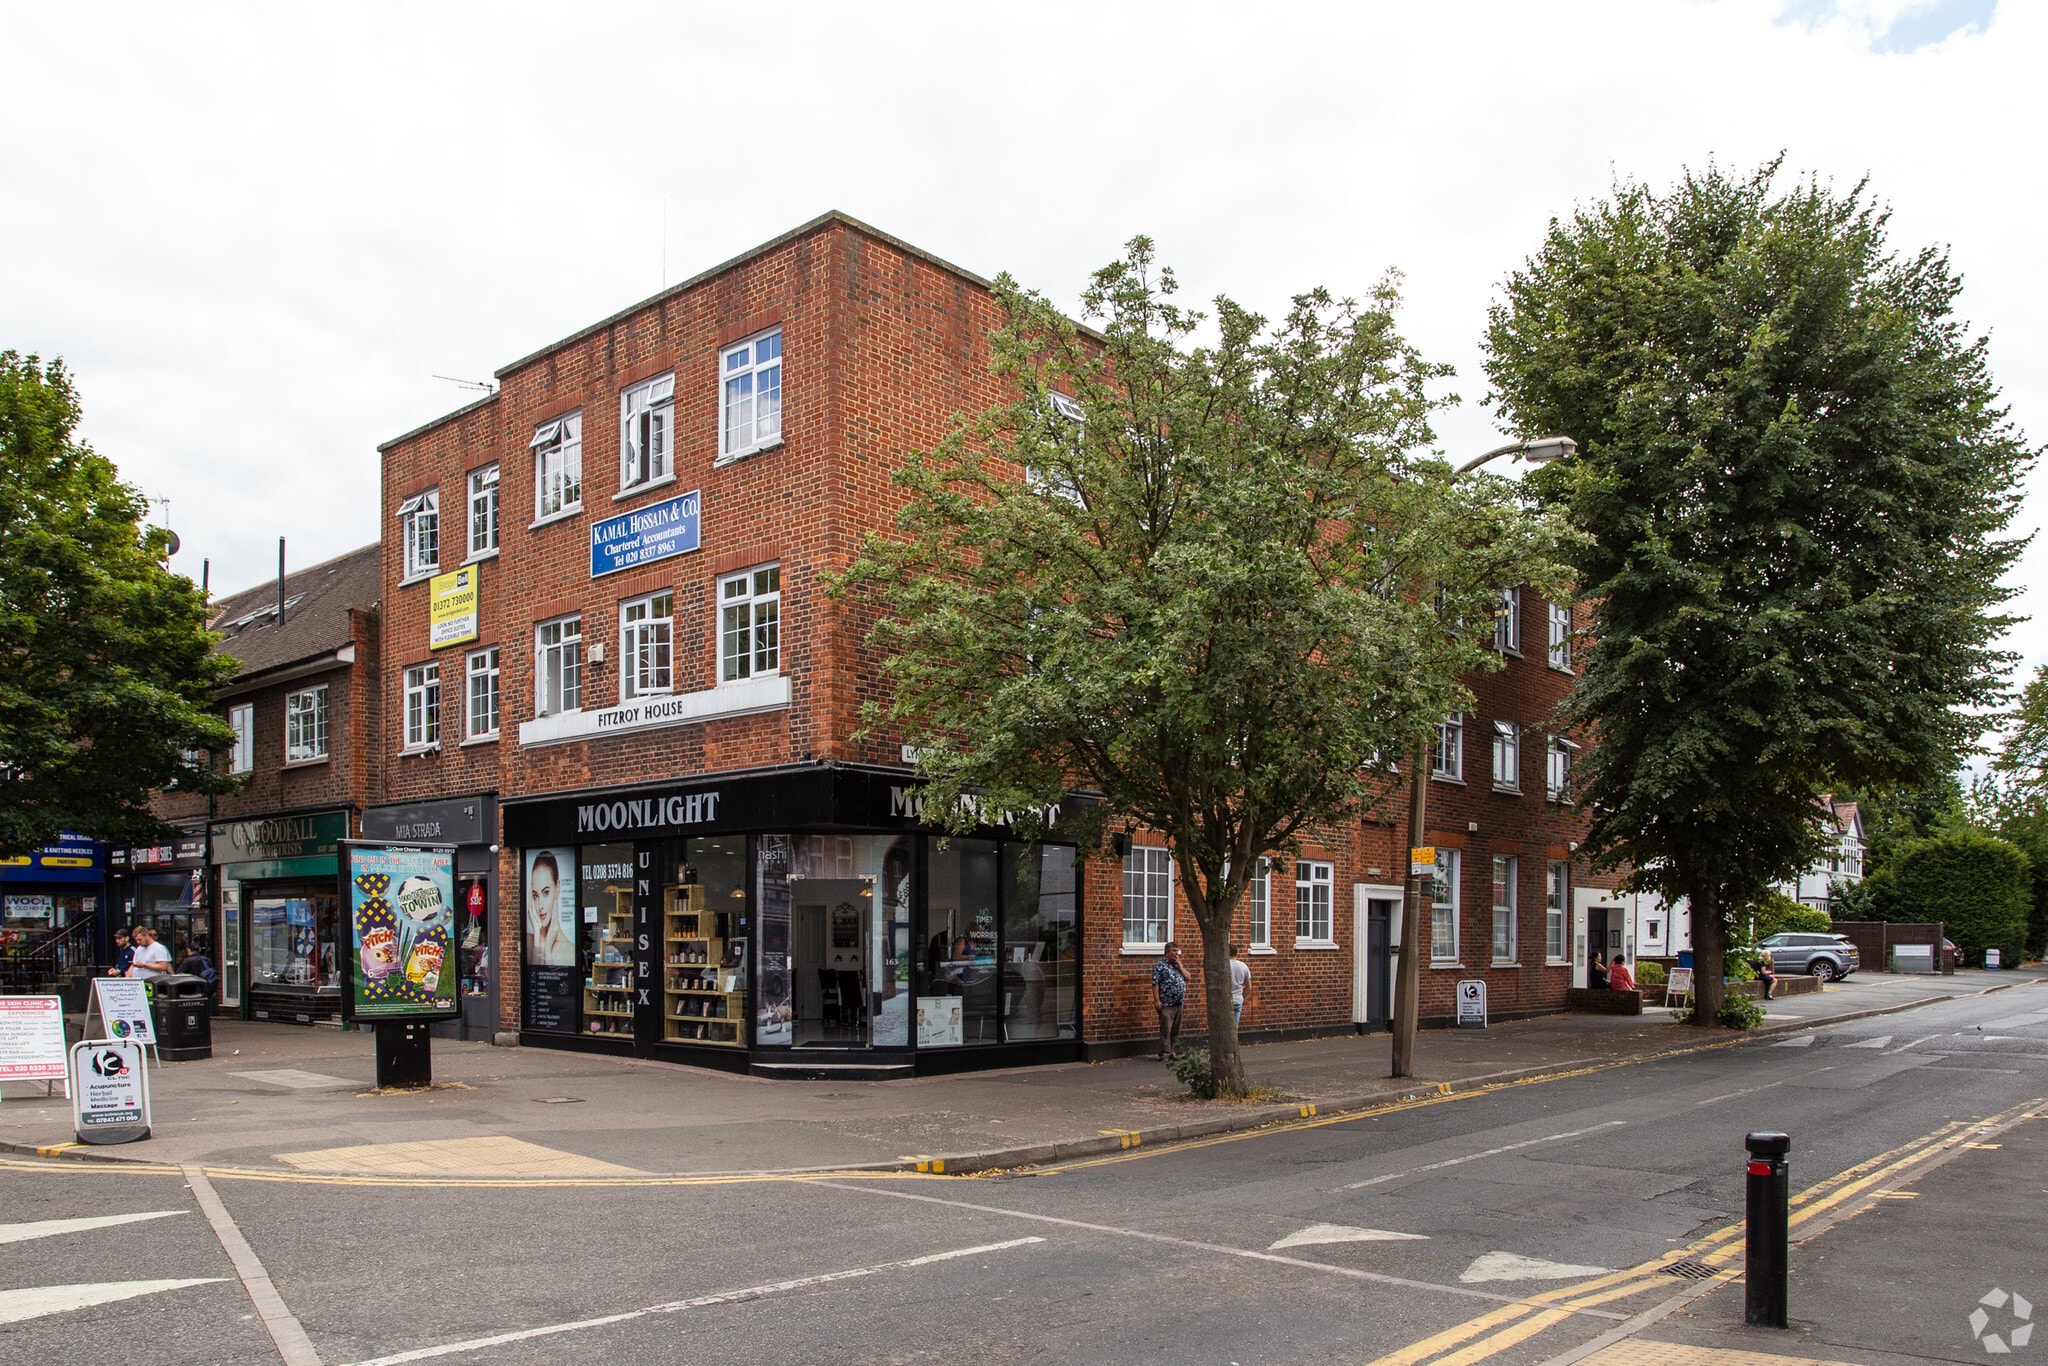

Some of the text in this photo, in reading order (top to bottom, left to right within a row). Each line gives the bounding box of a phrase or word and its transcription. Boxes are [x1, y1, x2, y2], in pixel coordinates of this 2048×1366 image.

[593, 521, 628, 546] KAMAL
[630, 508, 668, 534] HOSSAIN
[670, 502, 680, 522] &
[604, 524, 686, 556] Chartered Accountants
[614, 540, 676, 566] Tel 020 8337 8963
[458, 574, 468, 584] Bell
[433, 592, 474, 612] 01372 730000
[454, 616, 470, 624] FURTHER
[598, 700, 683, 727] FITZROY HOUSE
[578, 792, 720, 832] MOONLIGHT
[396, 822, 442, 839] MIA STRADA
[758, 848, 786, 860] nashi
[582, 865, 592, 880] TEL
[593, 864, 607, 879] 0208
[402, 896, 440, 914] TO WIN
[638, 852, 650, 1006] UNISEX
[368, 969, 374, 978] 6
